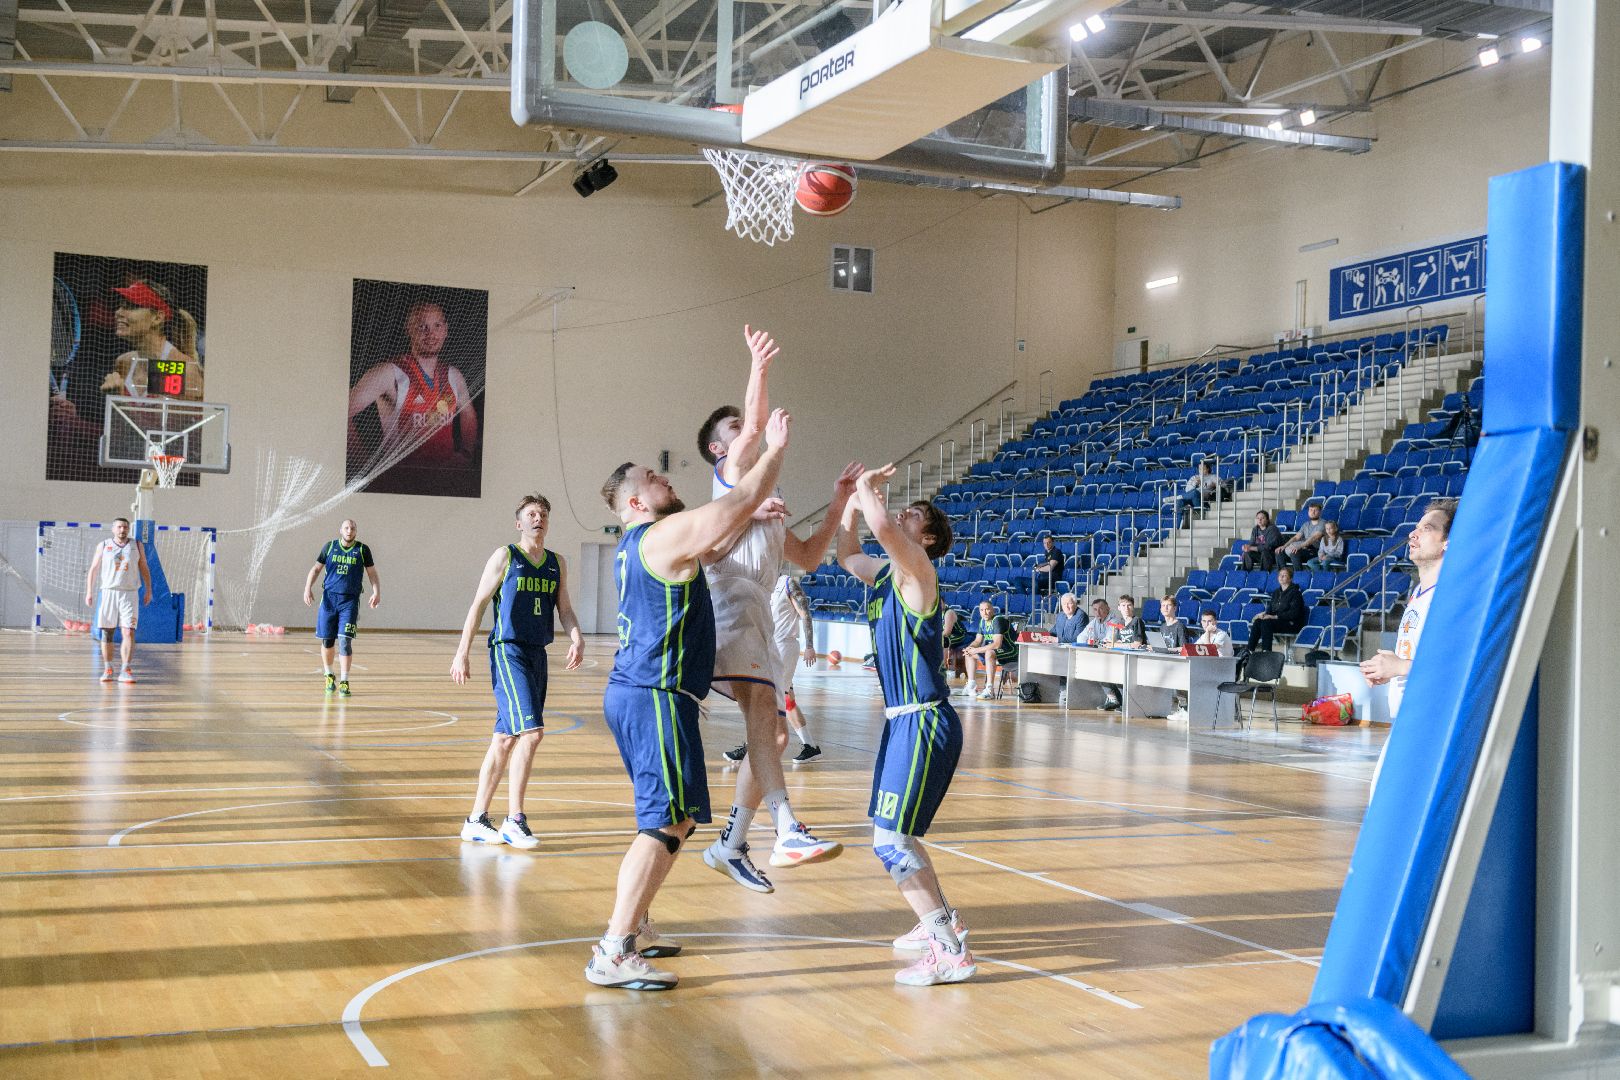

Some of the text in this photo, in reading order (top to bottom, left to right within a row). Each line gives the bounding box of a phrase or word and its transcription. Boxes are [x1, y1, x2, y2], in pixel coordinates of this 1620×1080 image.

[157, 361, 184, 375] 4:33
[164, 374, 182, 395] 18
[516, 576, 557, 594] ЛОБНЯ
[533, 597, 542, 616] 8
